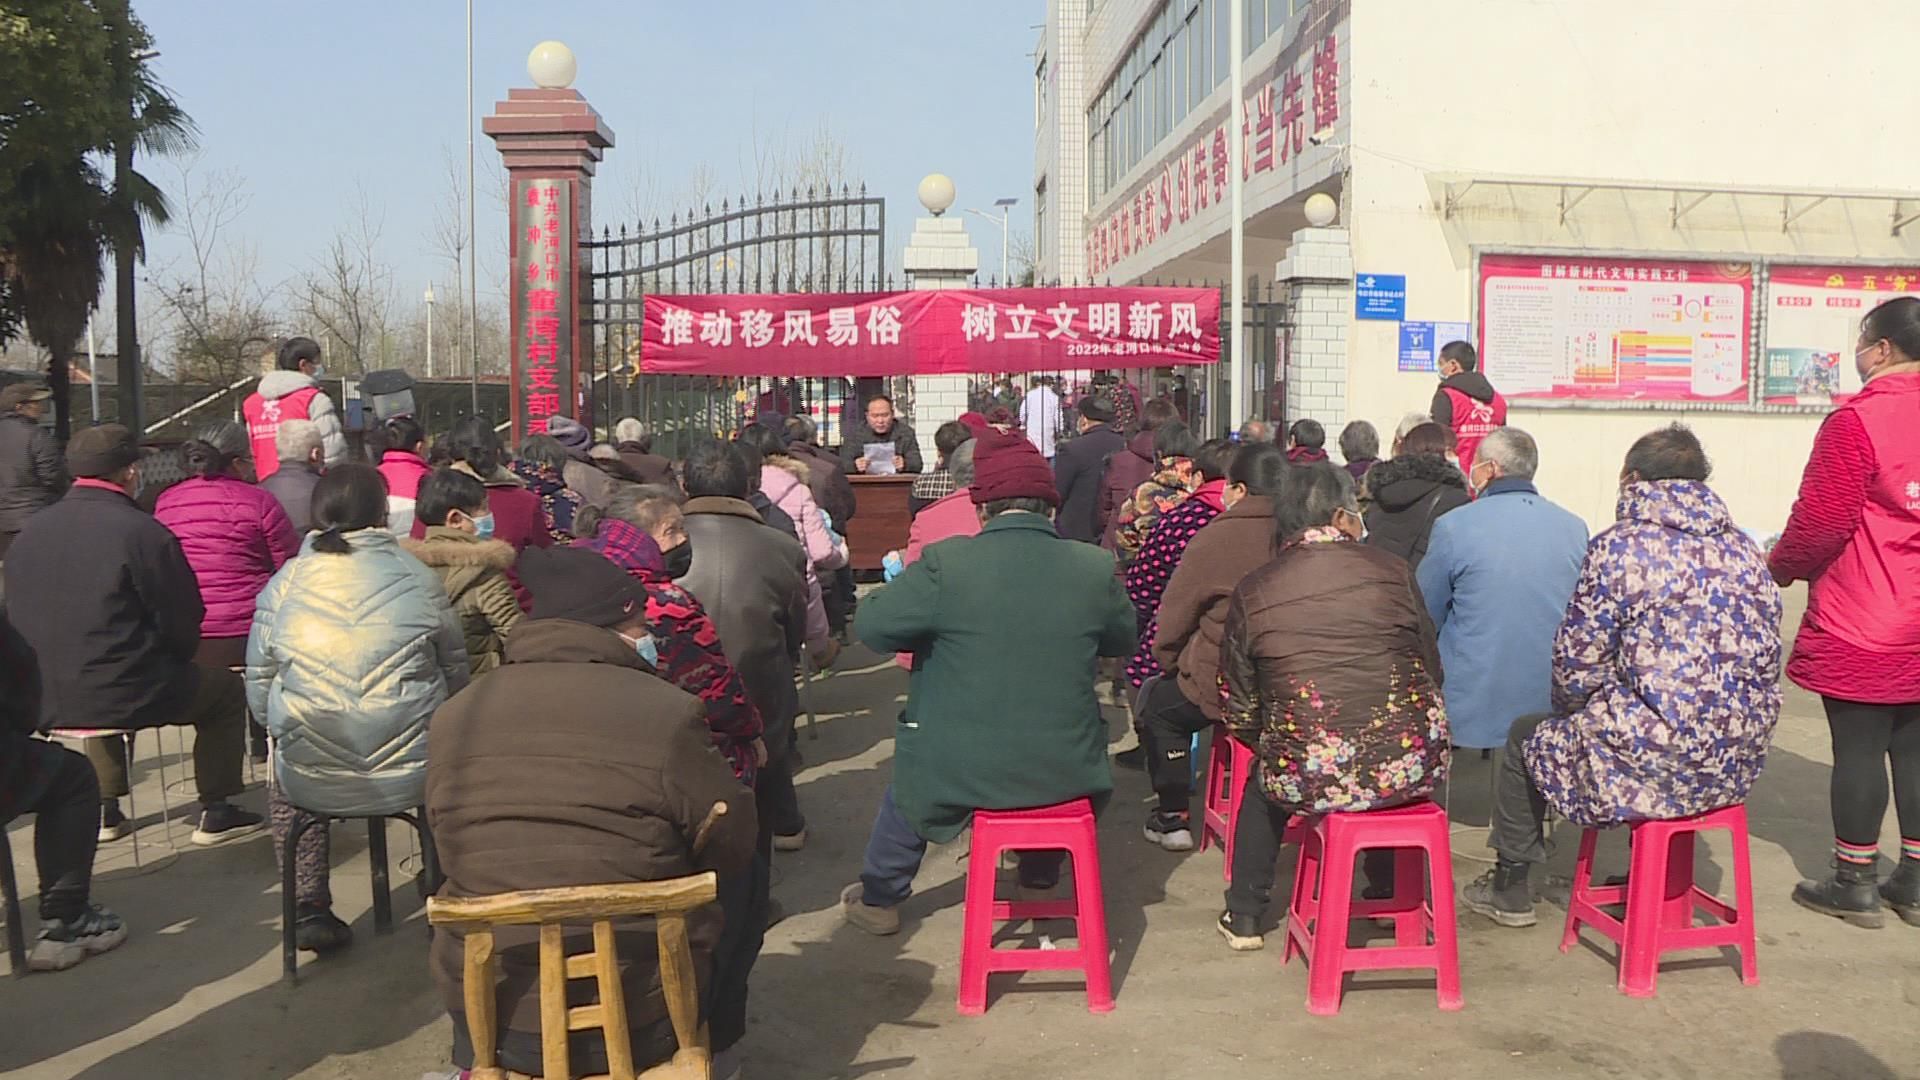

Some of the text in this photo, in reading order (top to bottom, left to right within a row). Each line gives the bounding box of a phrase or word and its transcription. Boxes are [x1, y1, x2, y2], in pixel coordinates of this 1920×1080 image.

[1178, 35, 1340, 224] 创先争当先锋
[543, 186, 560, 282] 中共老河口市
[1541, 264, 1689, 281] 图解新时代文明实践工作
[661, 301, 1201, 346] 推动移风易俗 树立文明新风
